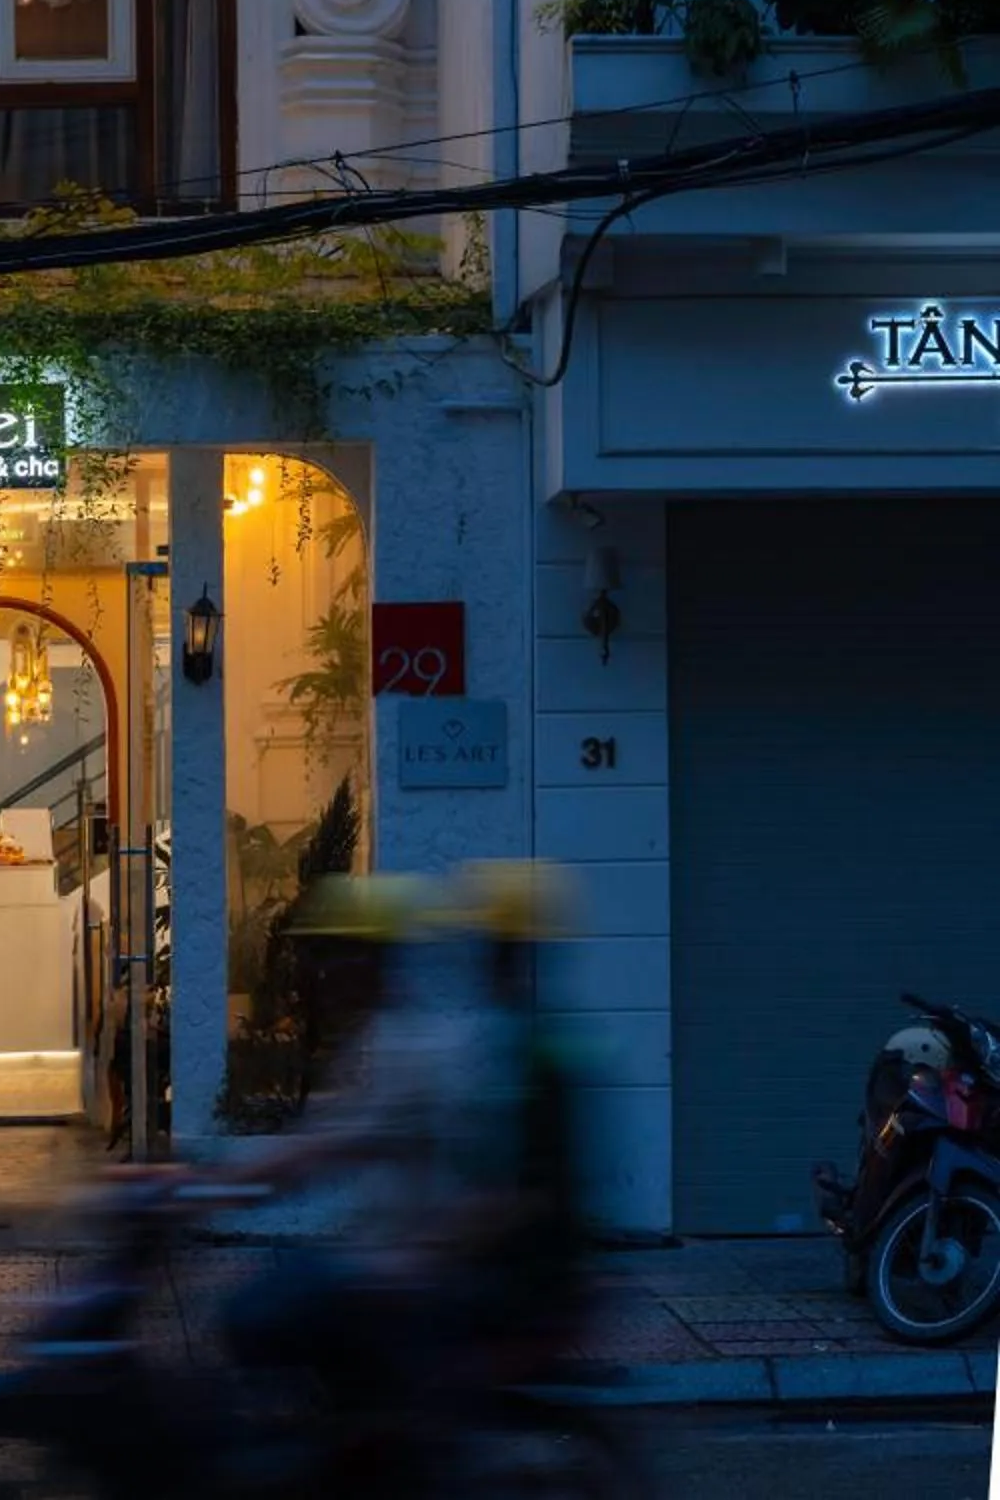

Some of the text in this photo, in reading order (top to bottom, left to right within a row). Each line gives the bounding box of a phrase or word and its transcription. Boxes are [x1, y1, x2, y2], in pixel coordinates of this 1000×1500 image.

[379, 646, 447, 696] 29
[405, 744, 499, 764] LES ART
[581, 737, 616, 768] 31
